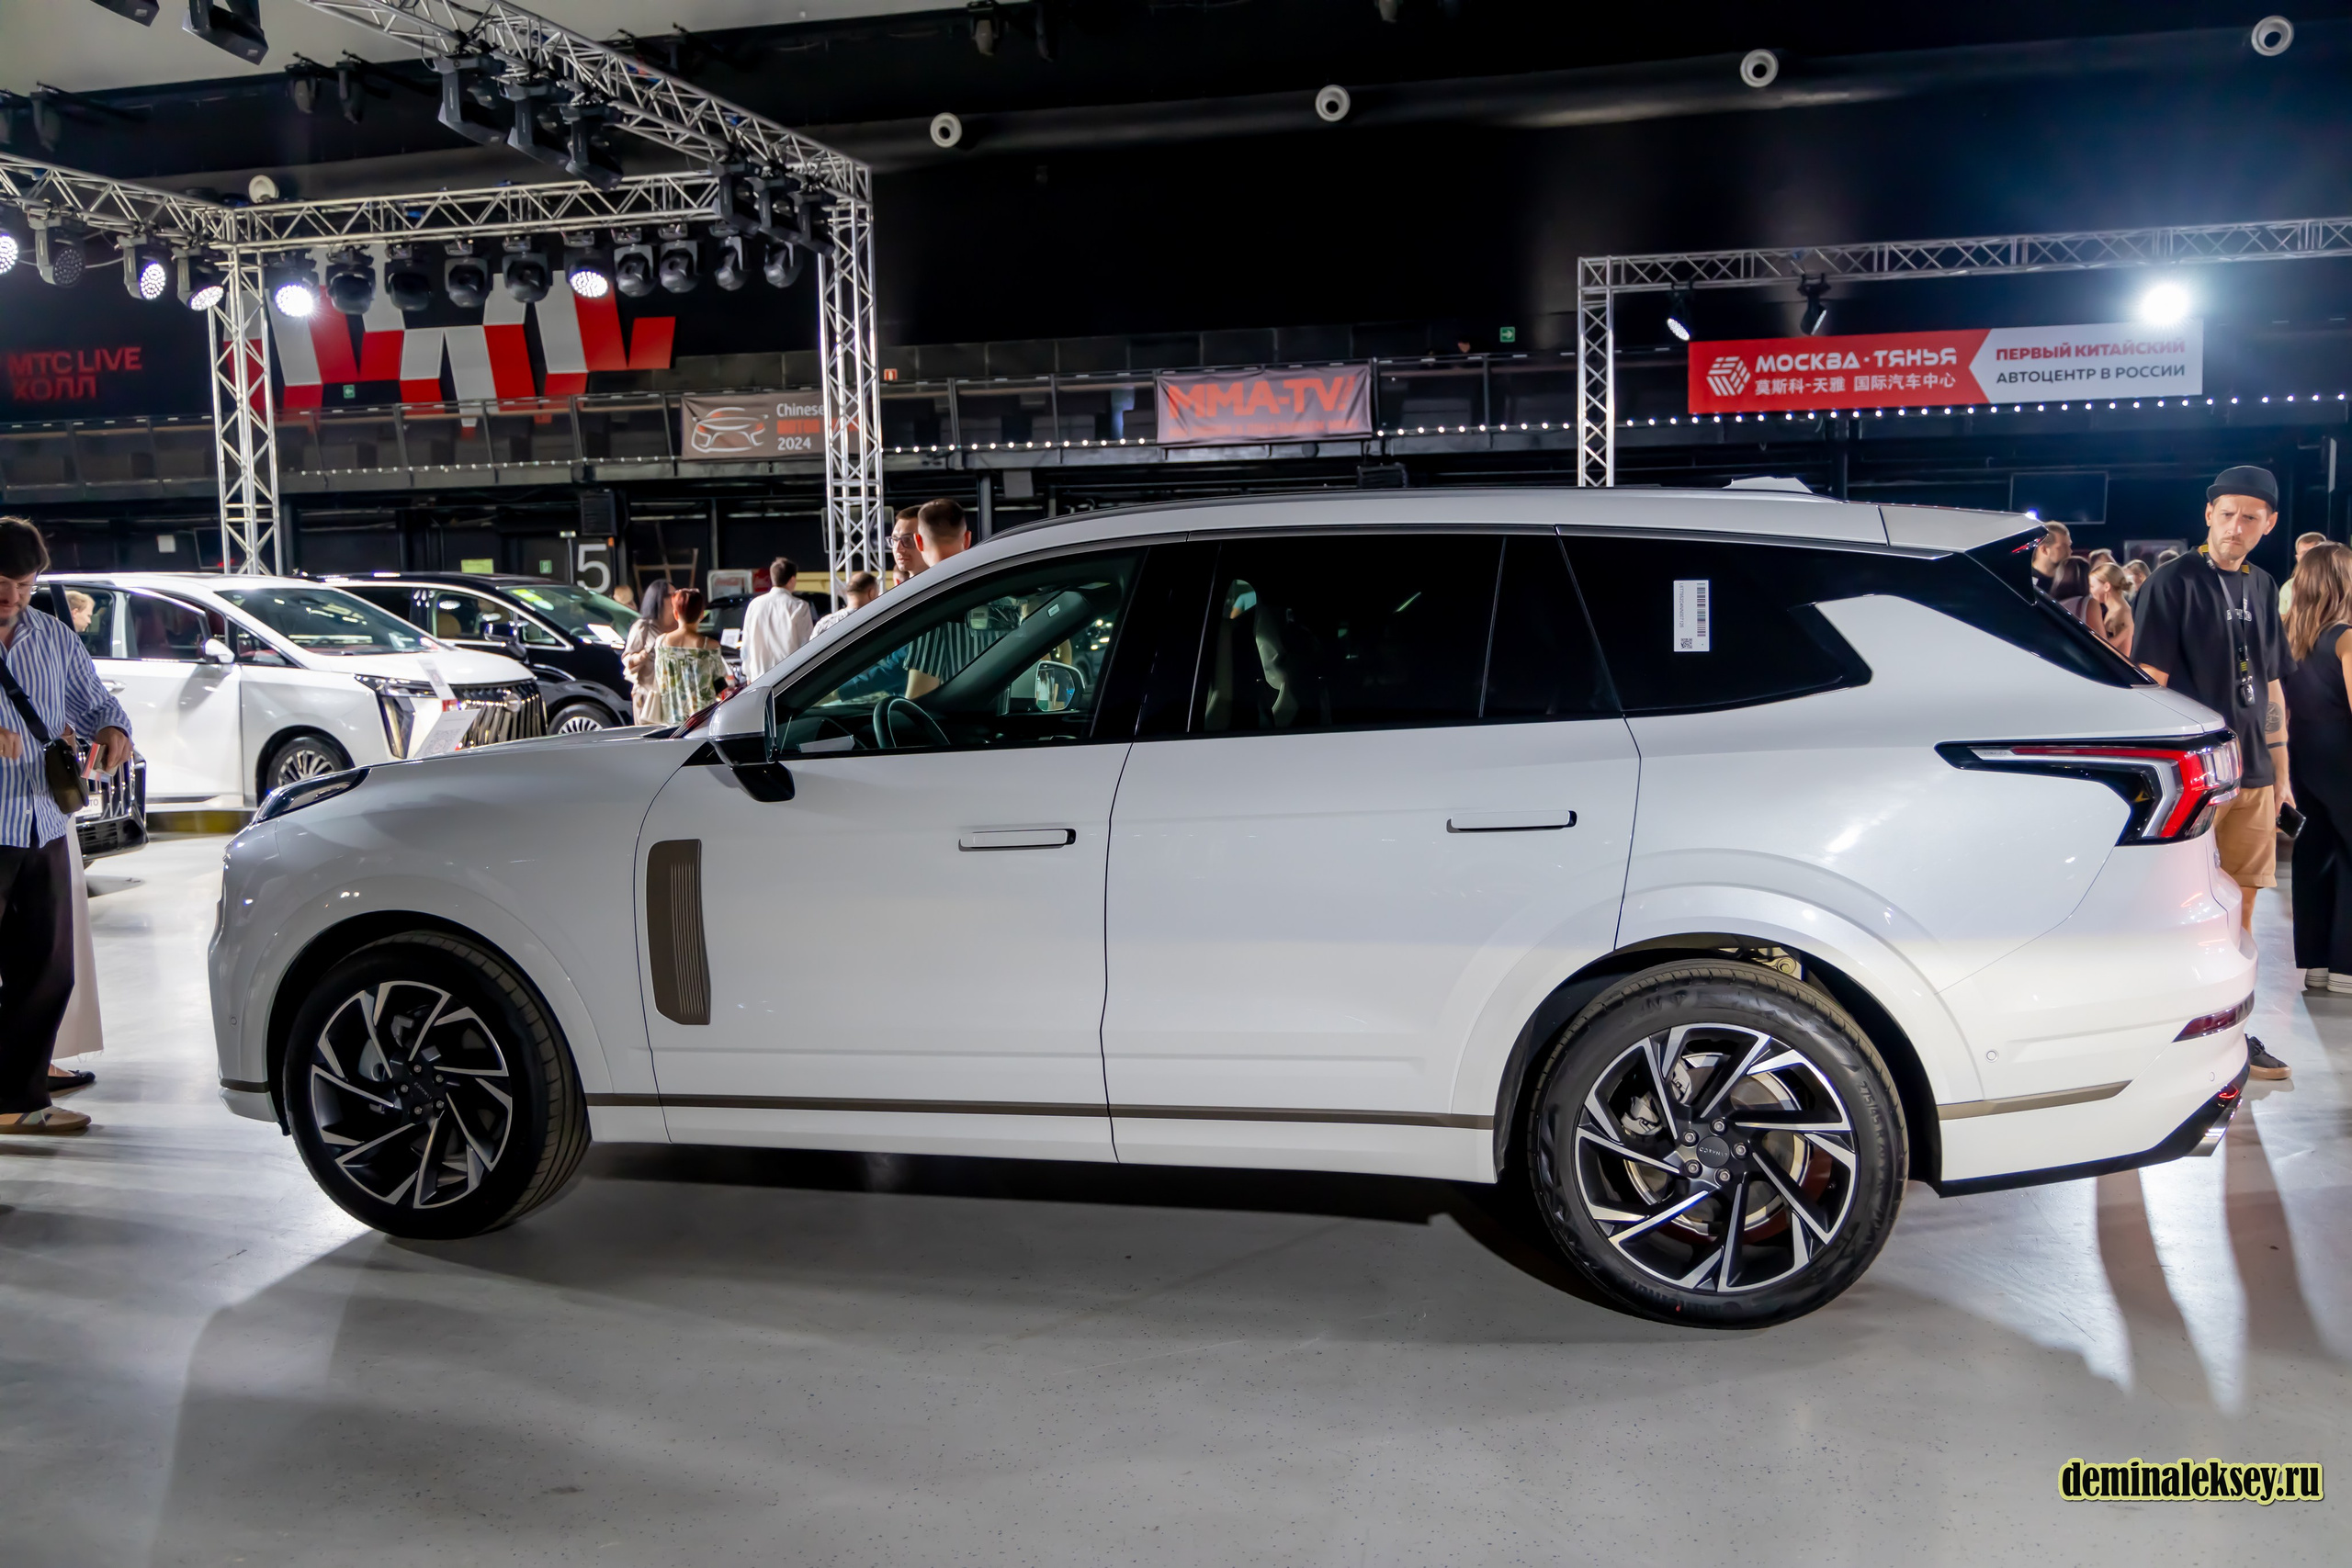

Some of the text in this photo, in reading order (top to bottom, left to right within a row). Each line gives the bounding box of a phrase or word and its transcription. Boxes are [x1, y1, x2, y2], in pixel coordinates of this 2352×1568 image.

[1996, 338, 2186, 361] ПЕРВЫЙ КИТАЙСКИЙ
[77, 347, 143, 374] LIVE
[1755, 351, 1861, 373] МОСКВА
[1853, 372, 1956, 392] 国际汽车中心
[1996, 365, 2186, 384] АВТОЦЕНТР В РОССИИ
[776, 402, 824, 418] Chinese
[777, 436, 811, 451] 2024
[576, 544, 611, 594] 5
